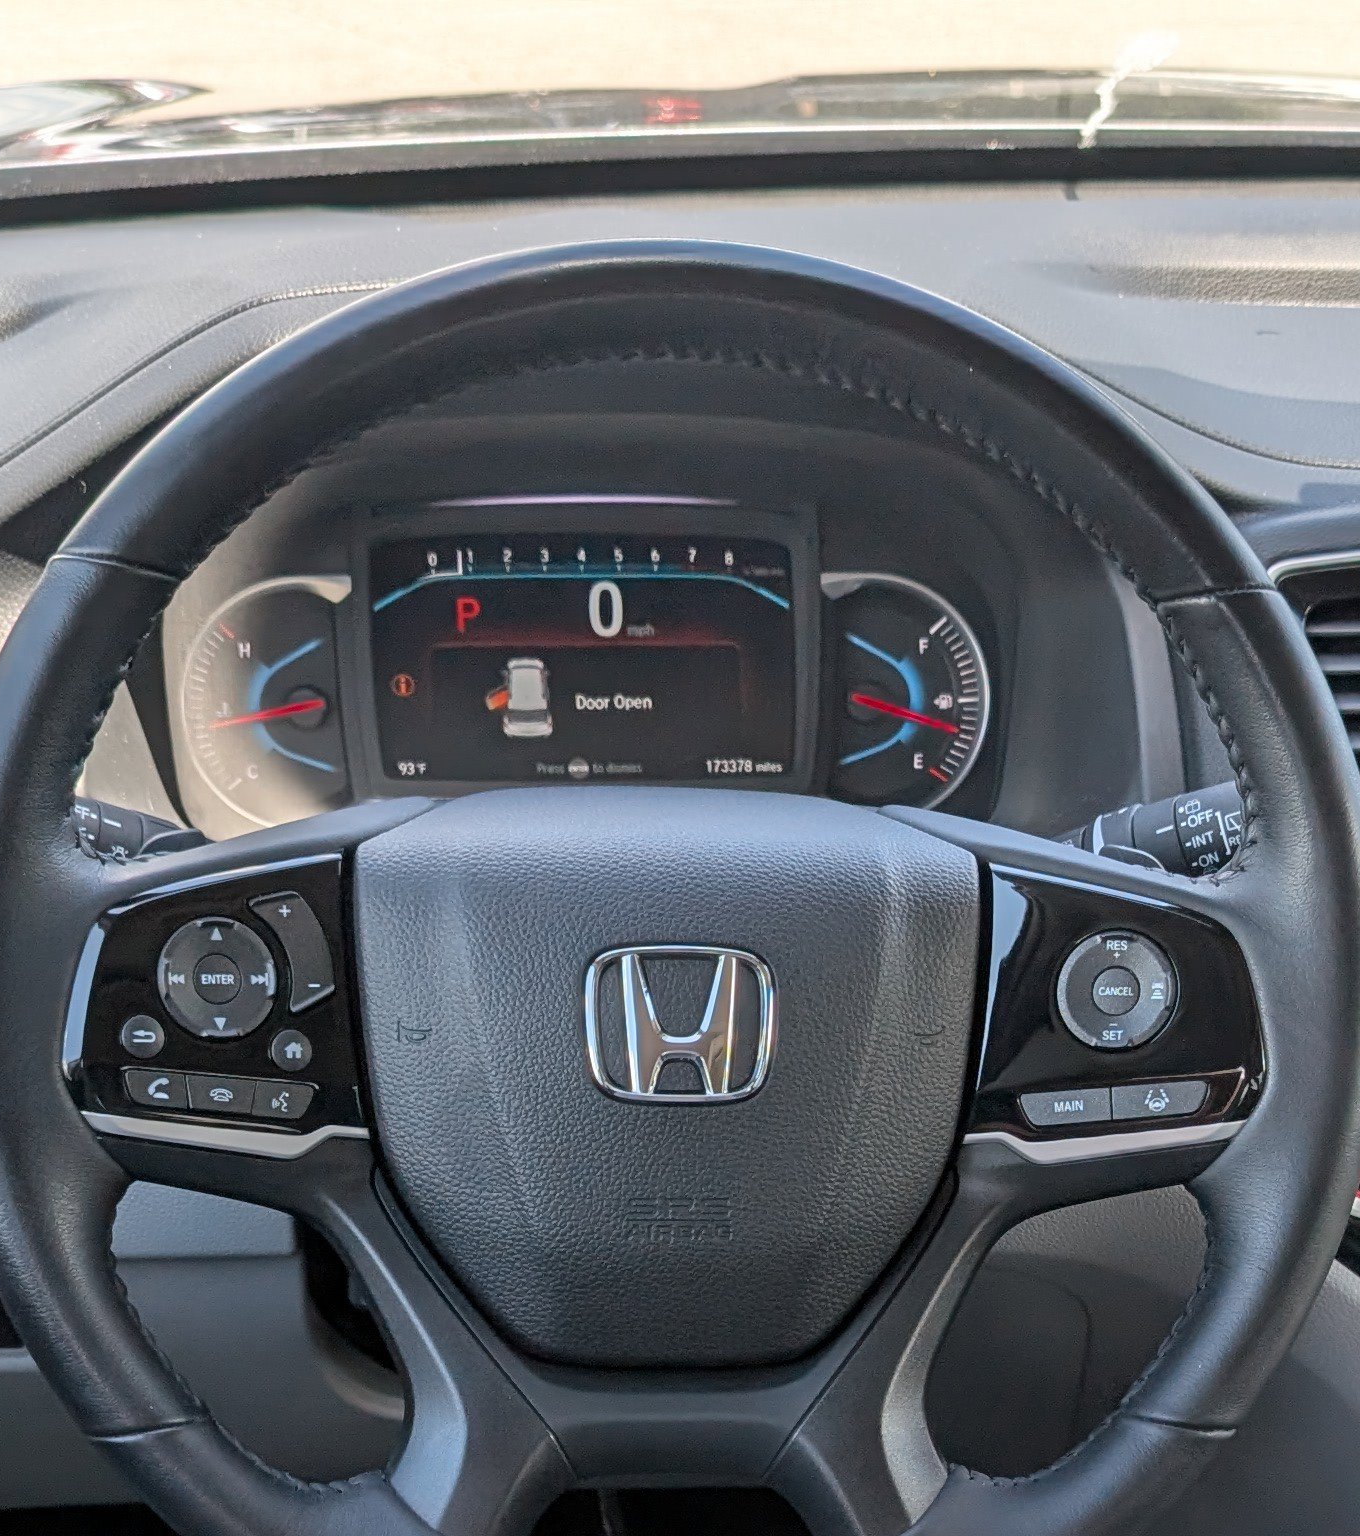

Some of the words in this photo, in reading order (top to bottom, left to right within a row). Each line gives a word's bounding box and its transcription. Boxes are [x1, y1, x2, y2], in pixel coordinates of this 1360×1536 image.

[427, 551, 437, 567] 0
[467, 548, 473, 564] 1
[503, 547, 512, 563] 2
[541, 547, 549, 563] 3
[614, 547, 623, 562] 5
[689, 547, 697, 563] 7
[724, 550, 734, 566] 8
[456, 597, 481, 633] P
[589, 580, 623, 637] 0
[238, 641, 251, 659] H
[918, 636, 929, 655] F
[575, 694, 610, 710] Door
[614, 694, 653, 713] Open
[705, 759, 753, 774] 173378
[913, 751, 924, 770] E
[247, 764, 259, 780] C
[1106, 940, 1128, 951] RES
[201, 974, 235, 985] ENTER
[1098, 987, 1134, 997] CANCEL
[1102, 1030, 1124, 1041] SET
[1054, 1101, 1084, 1113] MAIN
